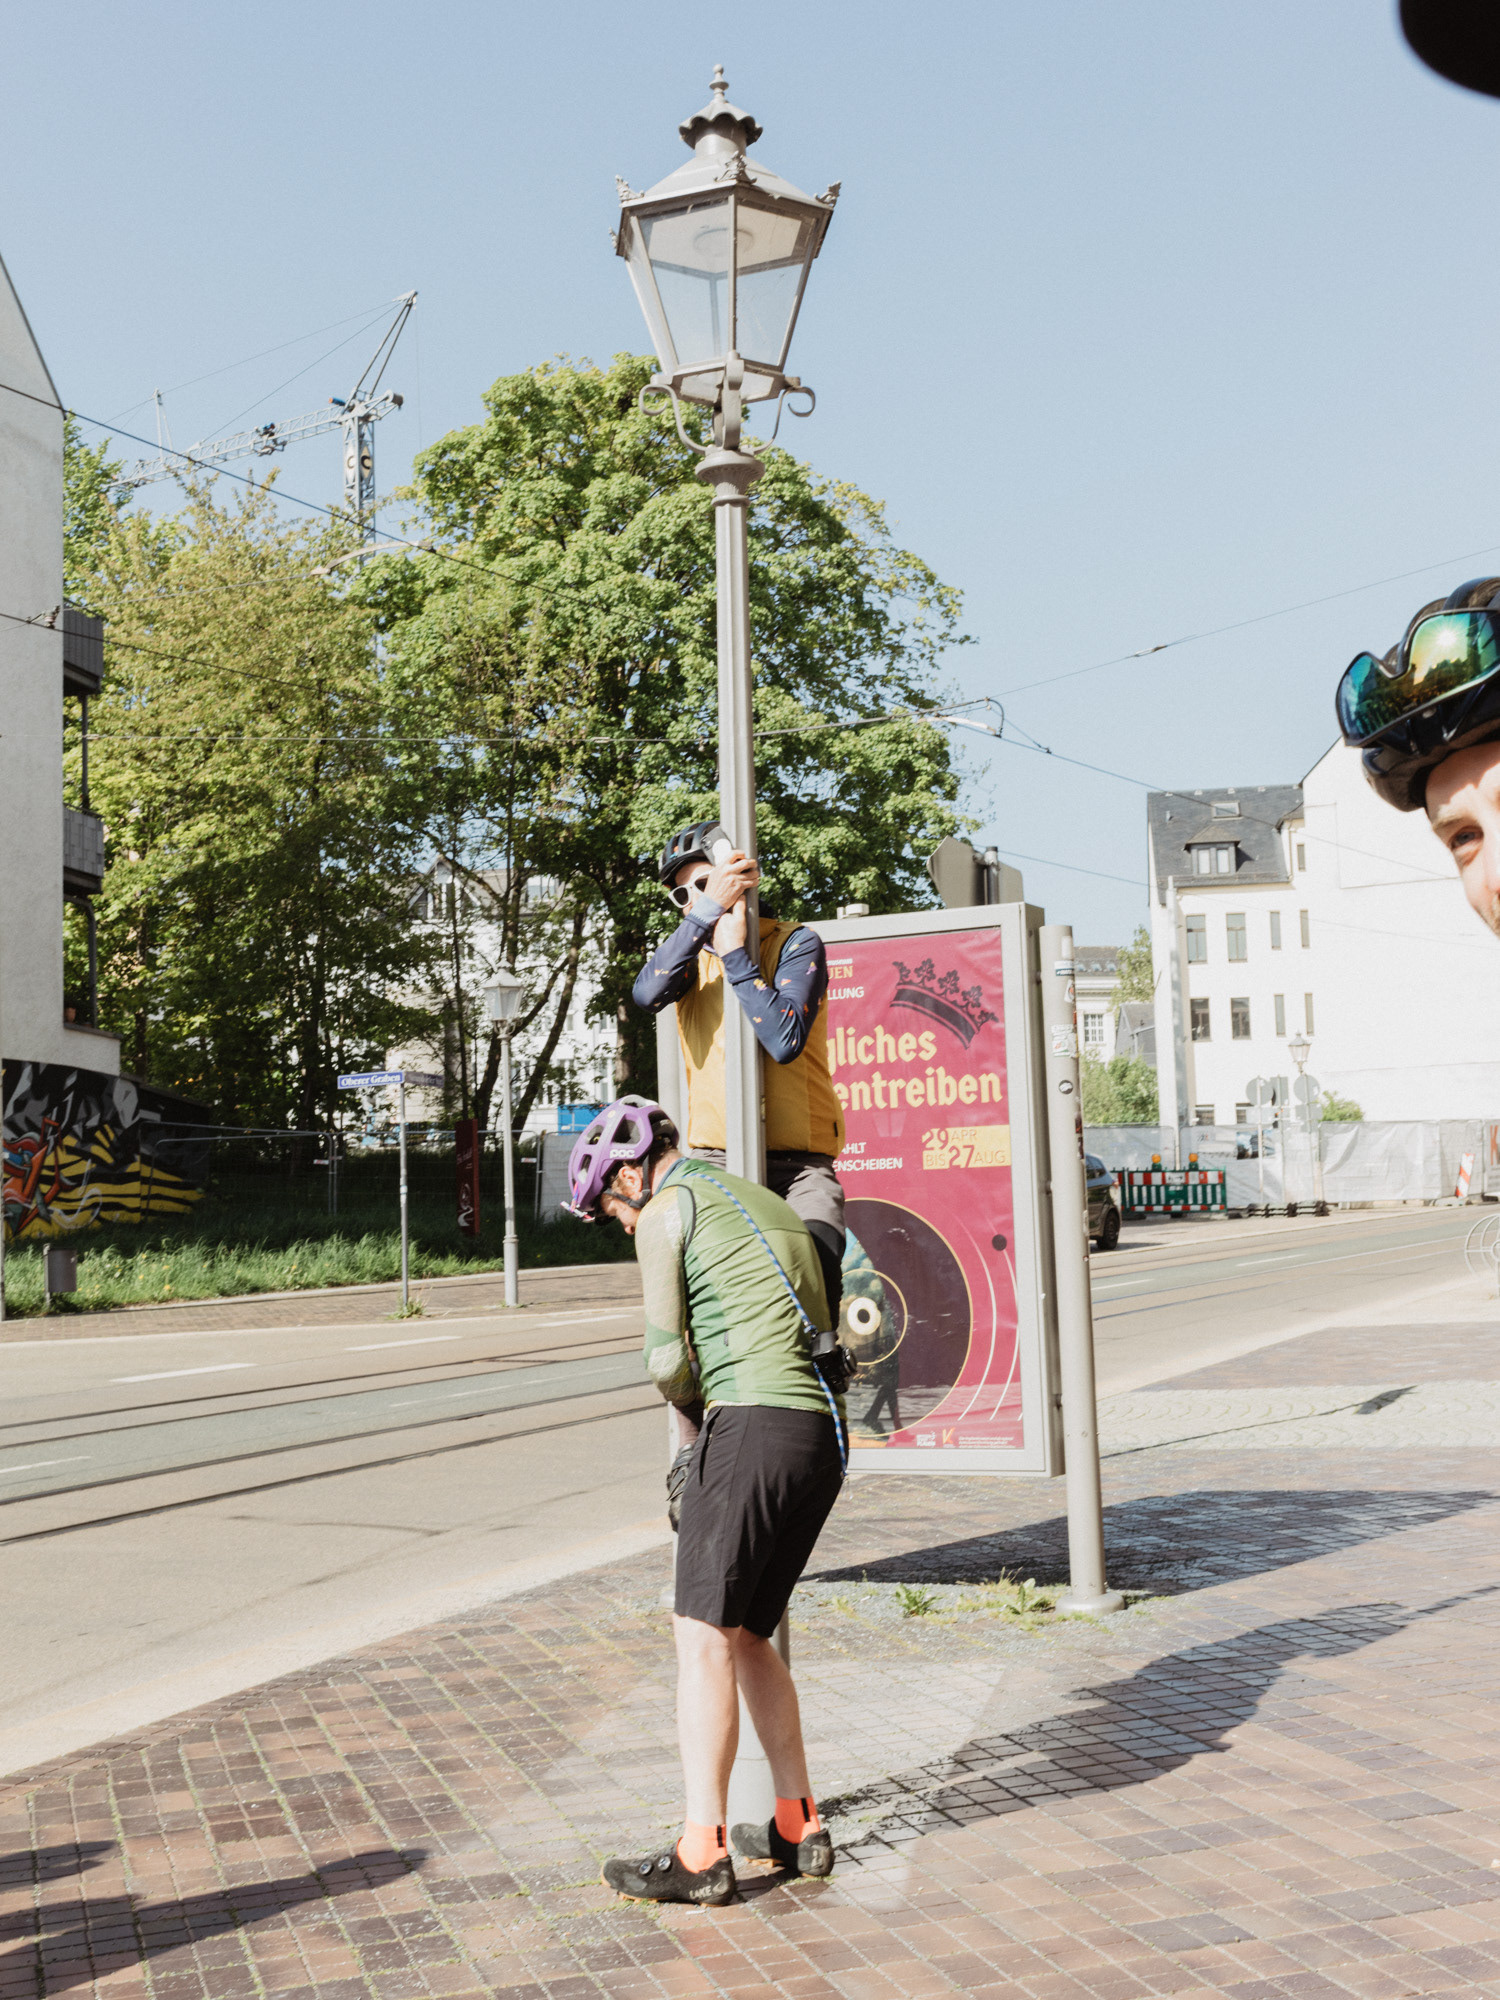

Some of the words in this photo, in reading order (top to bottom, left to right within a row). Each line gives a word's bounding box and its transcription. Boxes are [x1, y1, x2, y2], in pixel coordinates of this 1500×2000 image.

[921, 1128, 949, 1151] 29
[951, 1129, 978, 1142] APR
[926, 1154, 946, 1167] BIS
[949, 1145, 975, 1168] 27
[974, 1149, 1006, 1165] AUG
